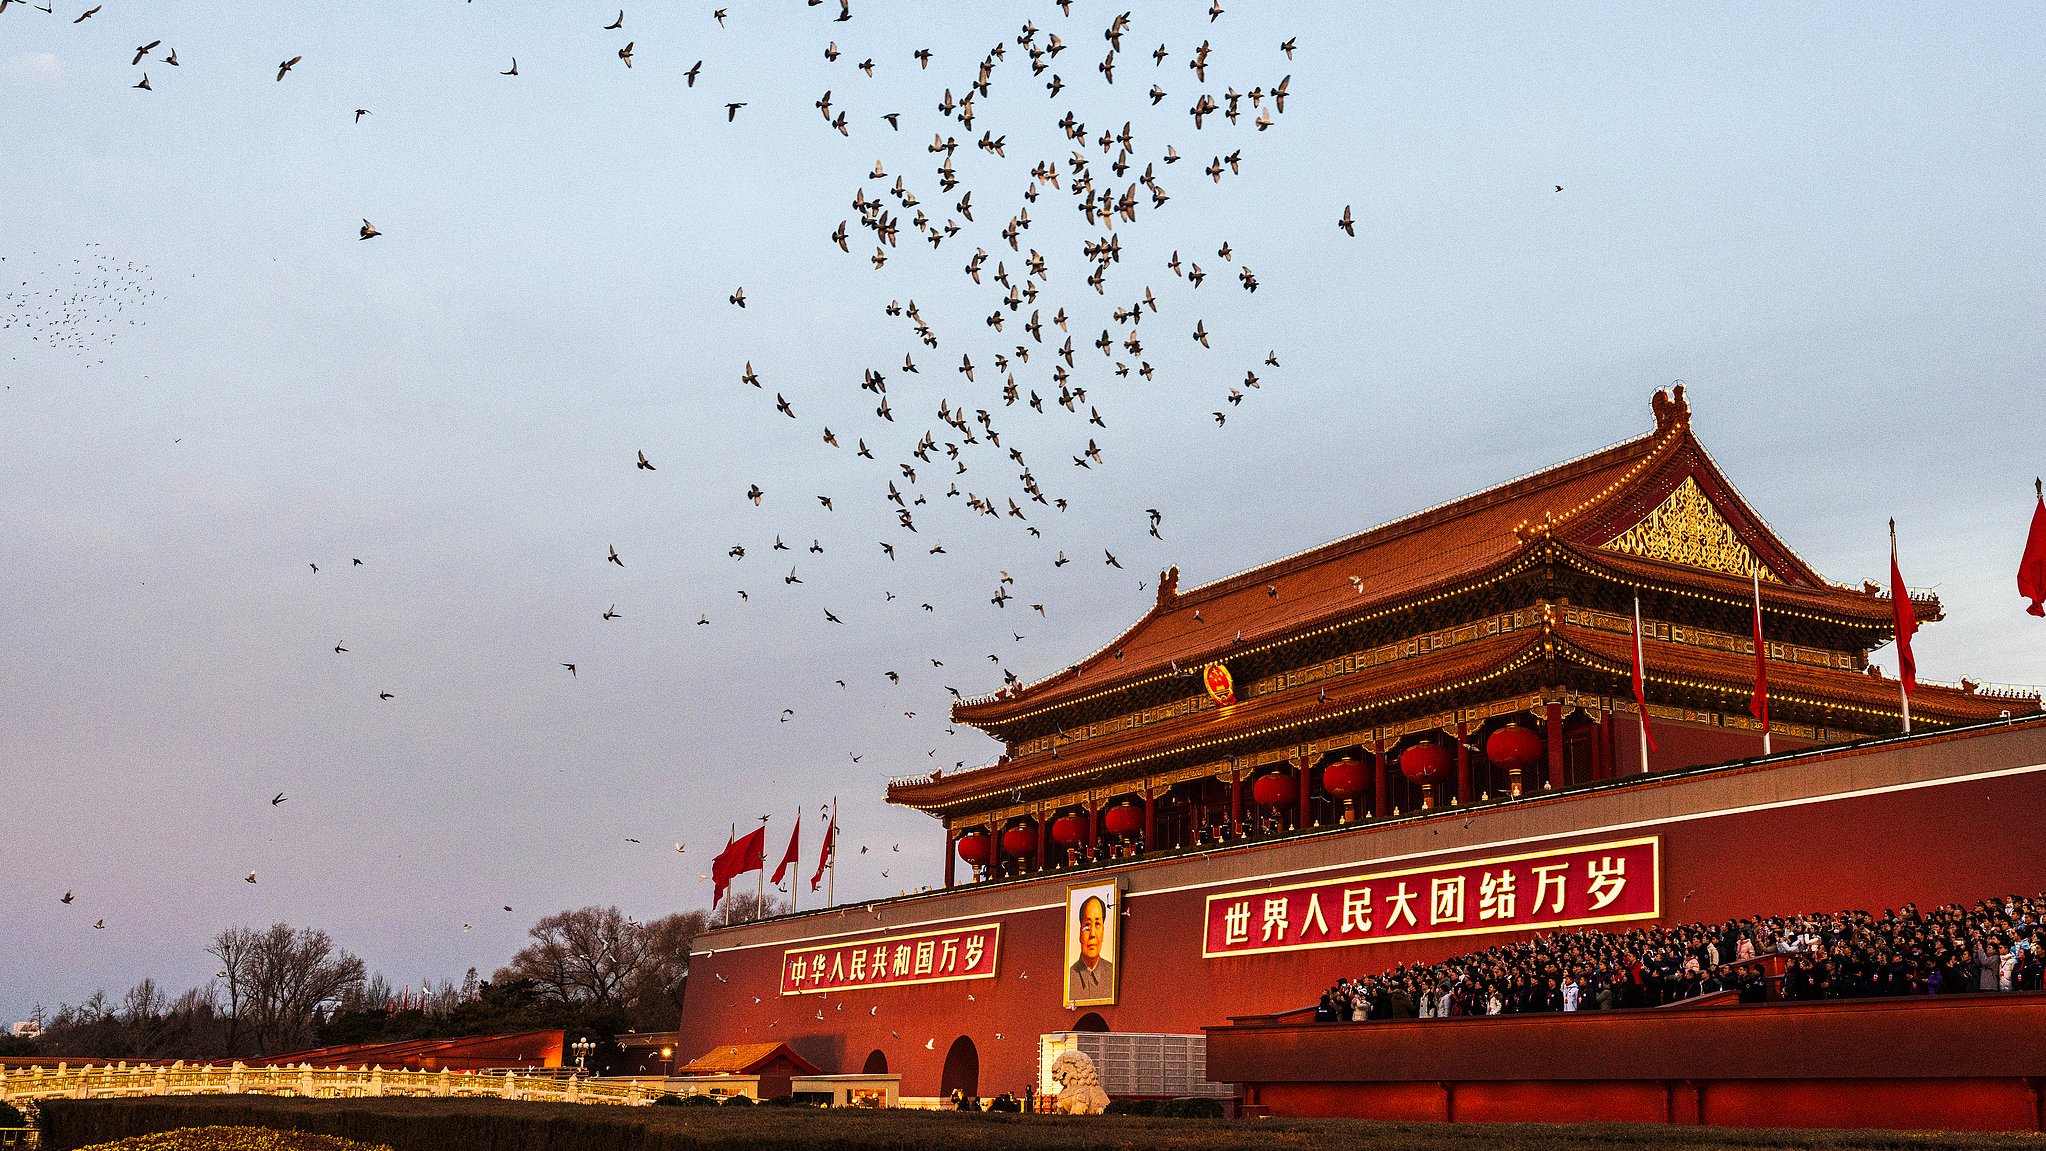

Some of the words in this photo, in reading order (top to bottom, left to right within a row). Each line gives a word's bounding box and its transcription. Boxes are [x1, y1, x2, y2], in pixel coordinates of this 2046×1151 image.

[1225, 857, 1626, 945] 世界人民大团结万岁
[791, 935, 985, 986] 中华人民共和国万岁
